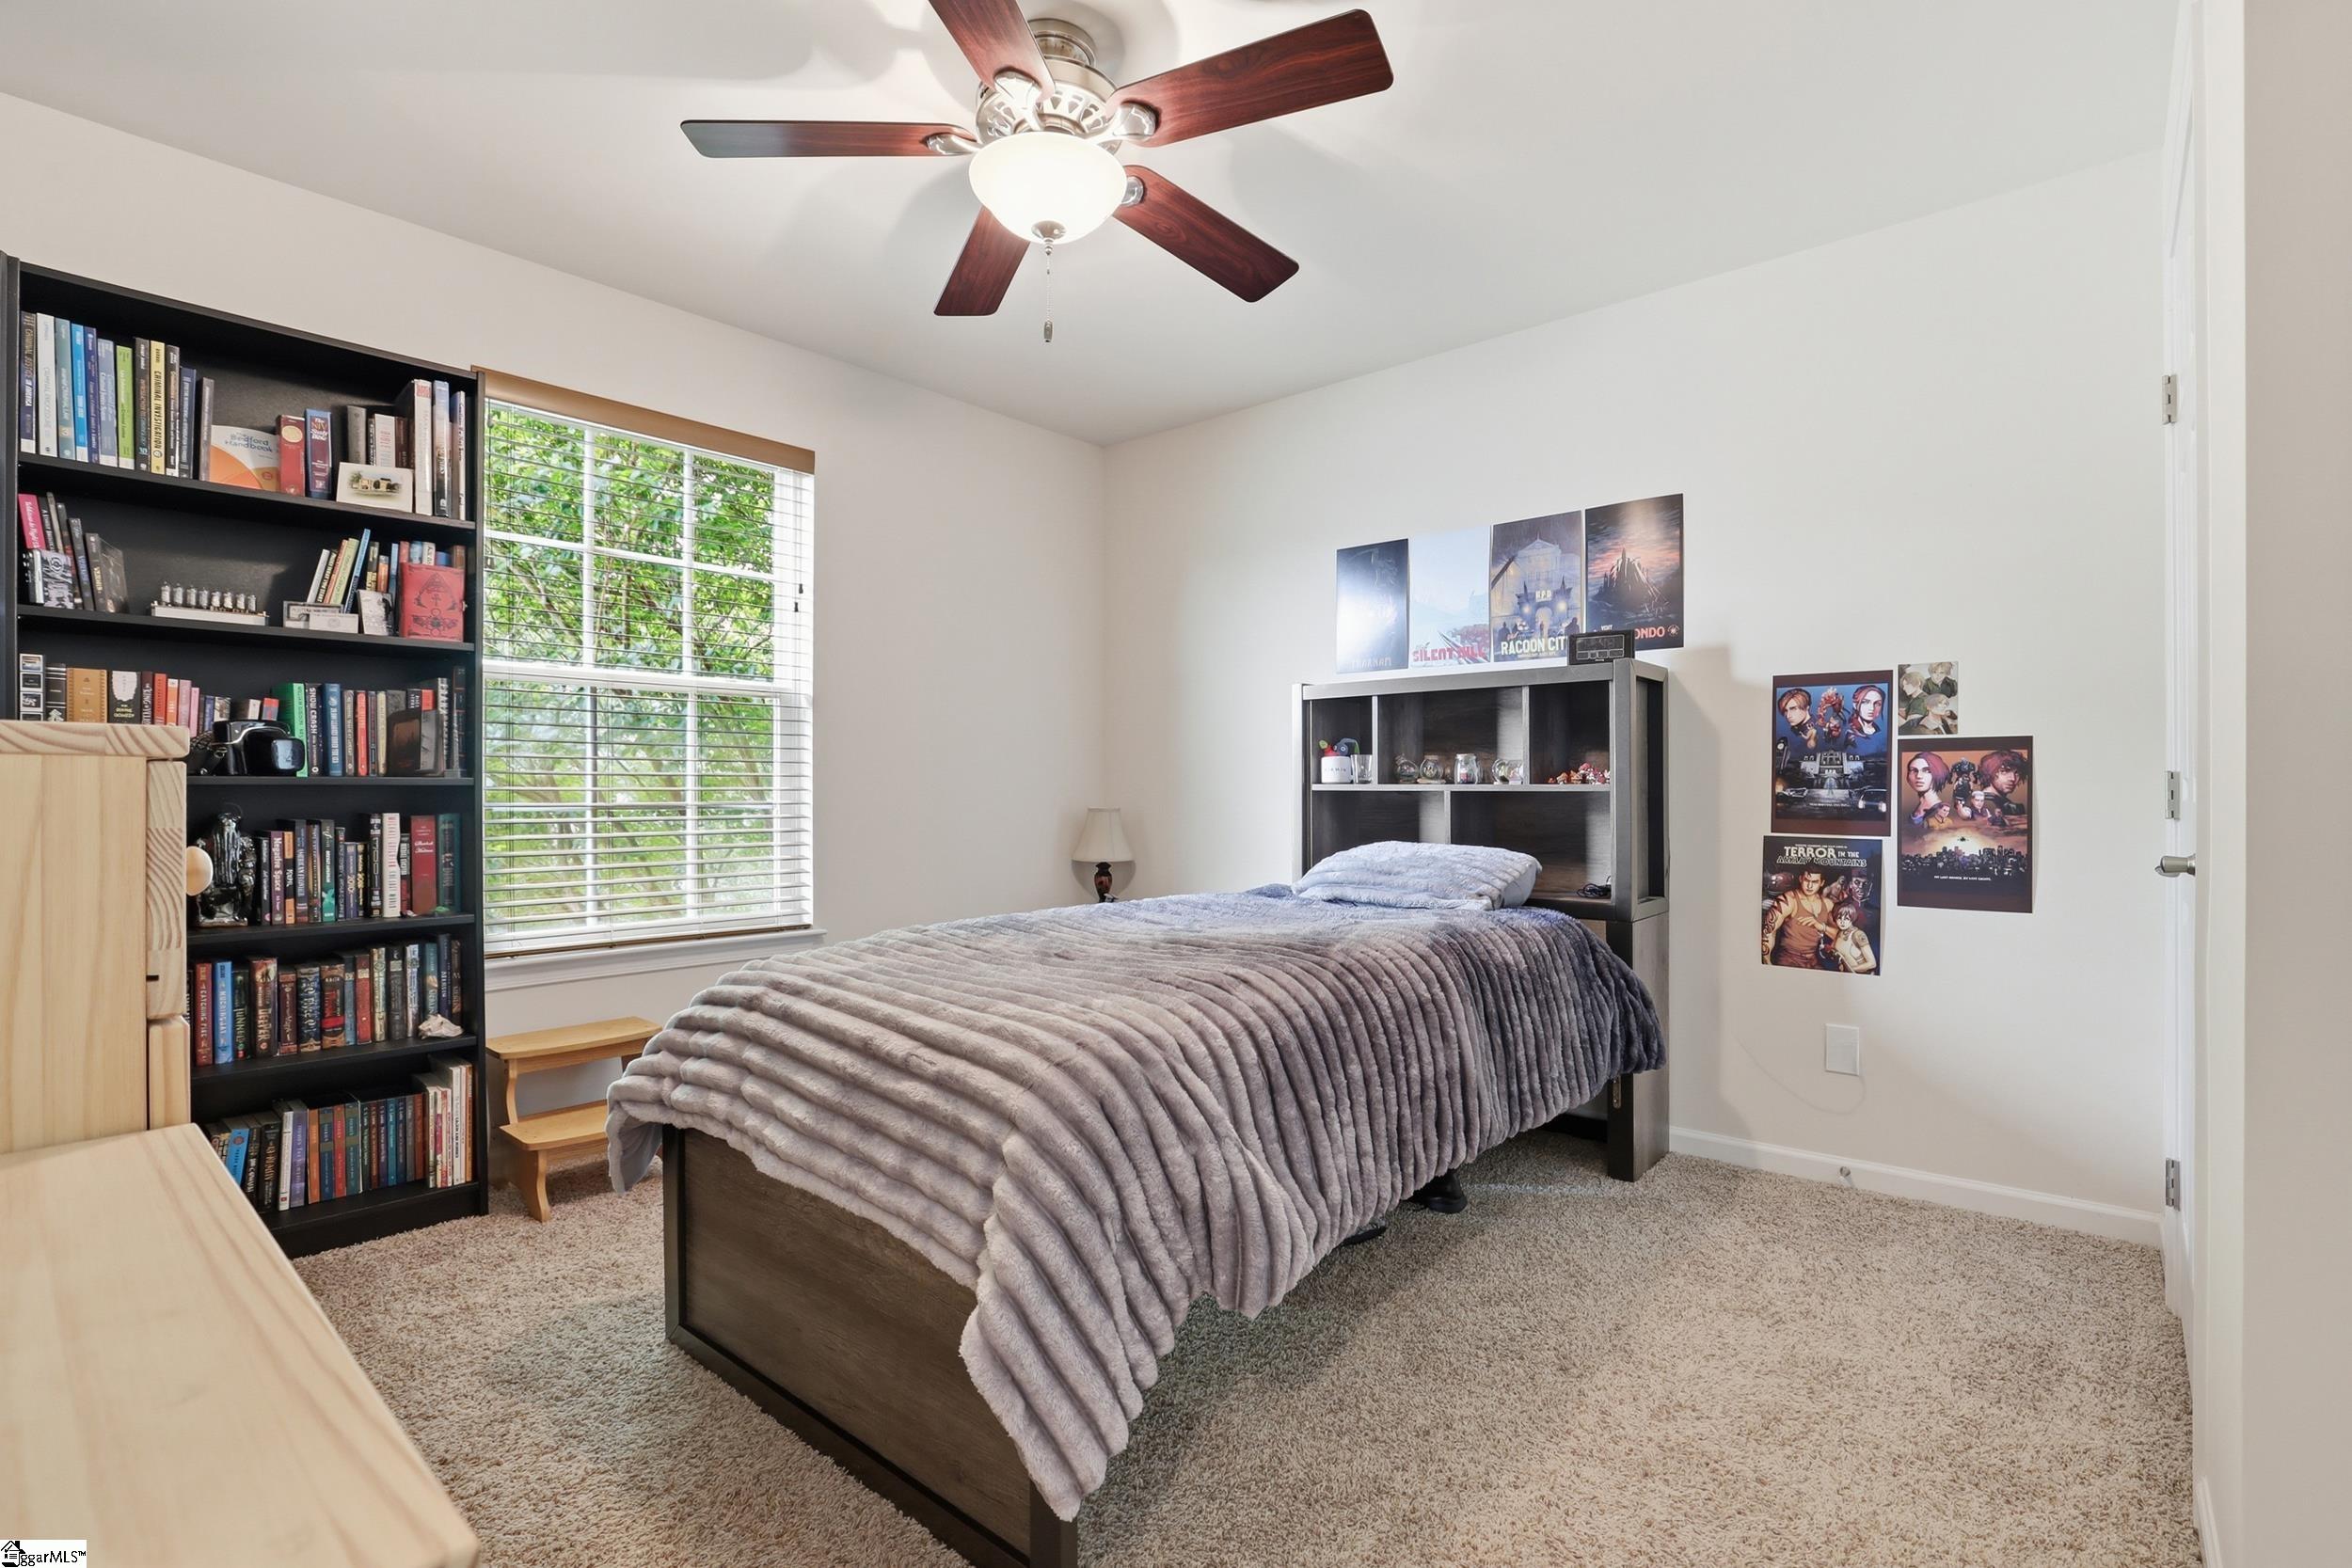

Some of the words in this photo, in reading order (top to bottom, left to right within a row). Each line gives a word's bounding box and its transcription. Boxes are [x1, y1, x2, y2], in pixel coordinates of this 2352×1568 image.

[154, 403, 163, 450] INVESTIGATION
[1635, 626, 1665, 640] ONDO
[1412, 646, 1455, 662] SILENT
[1501, 638, 1547, 656] RACOON
[1548, 636, 1568, 652] CIT
[309, 688, 318, 710] SNOW
[310, 710, 319, 734] CRASH
[272, 837, 282, 869] Negative
[1784, 847, 1836, 858] TERROR
[1813, 857, 1867, 867] MOUNTAINS
[273, 869, 283, 892] Space
[218, 990, 228, 1035] MOCKINGJAY
[257, 1007, 273, 1041] DEEPER
